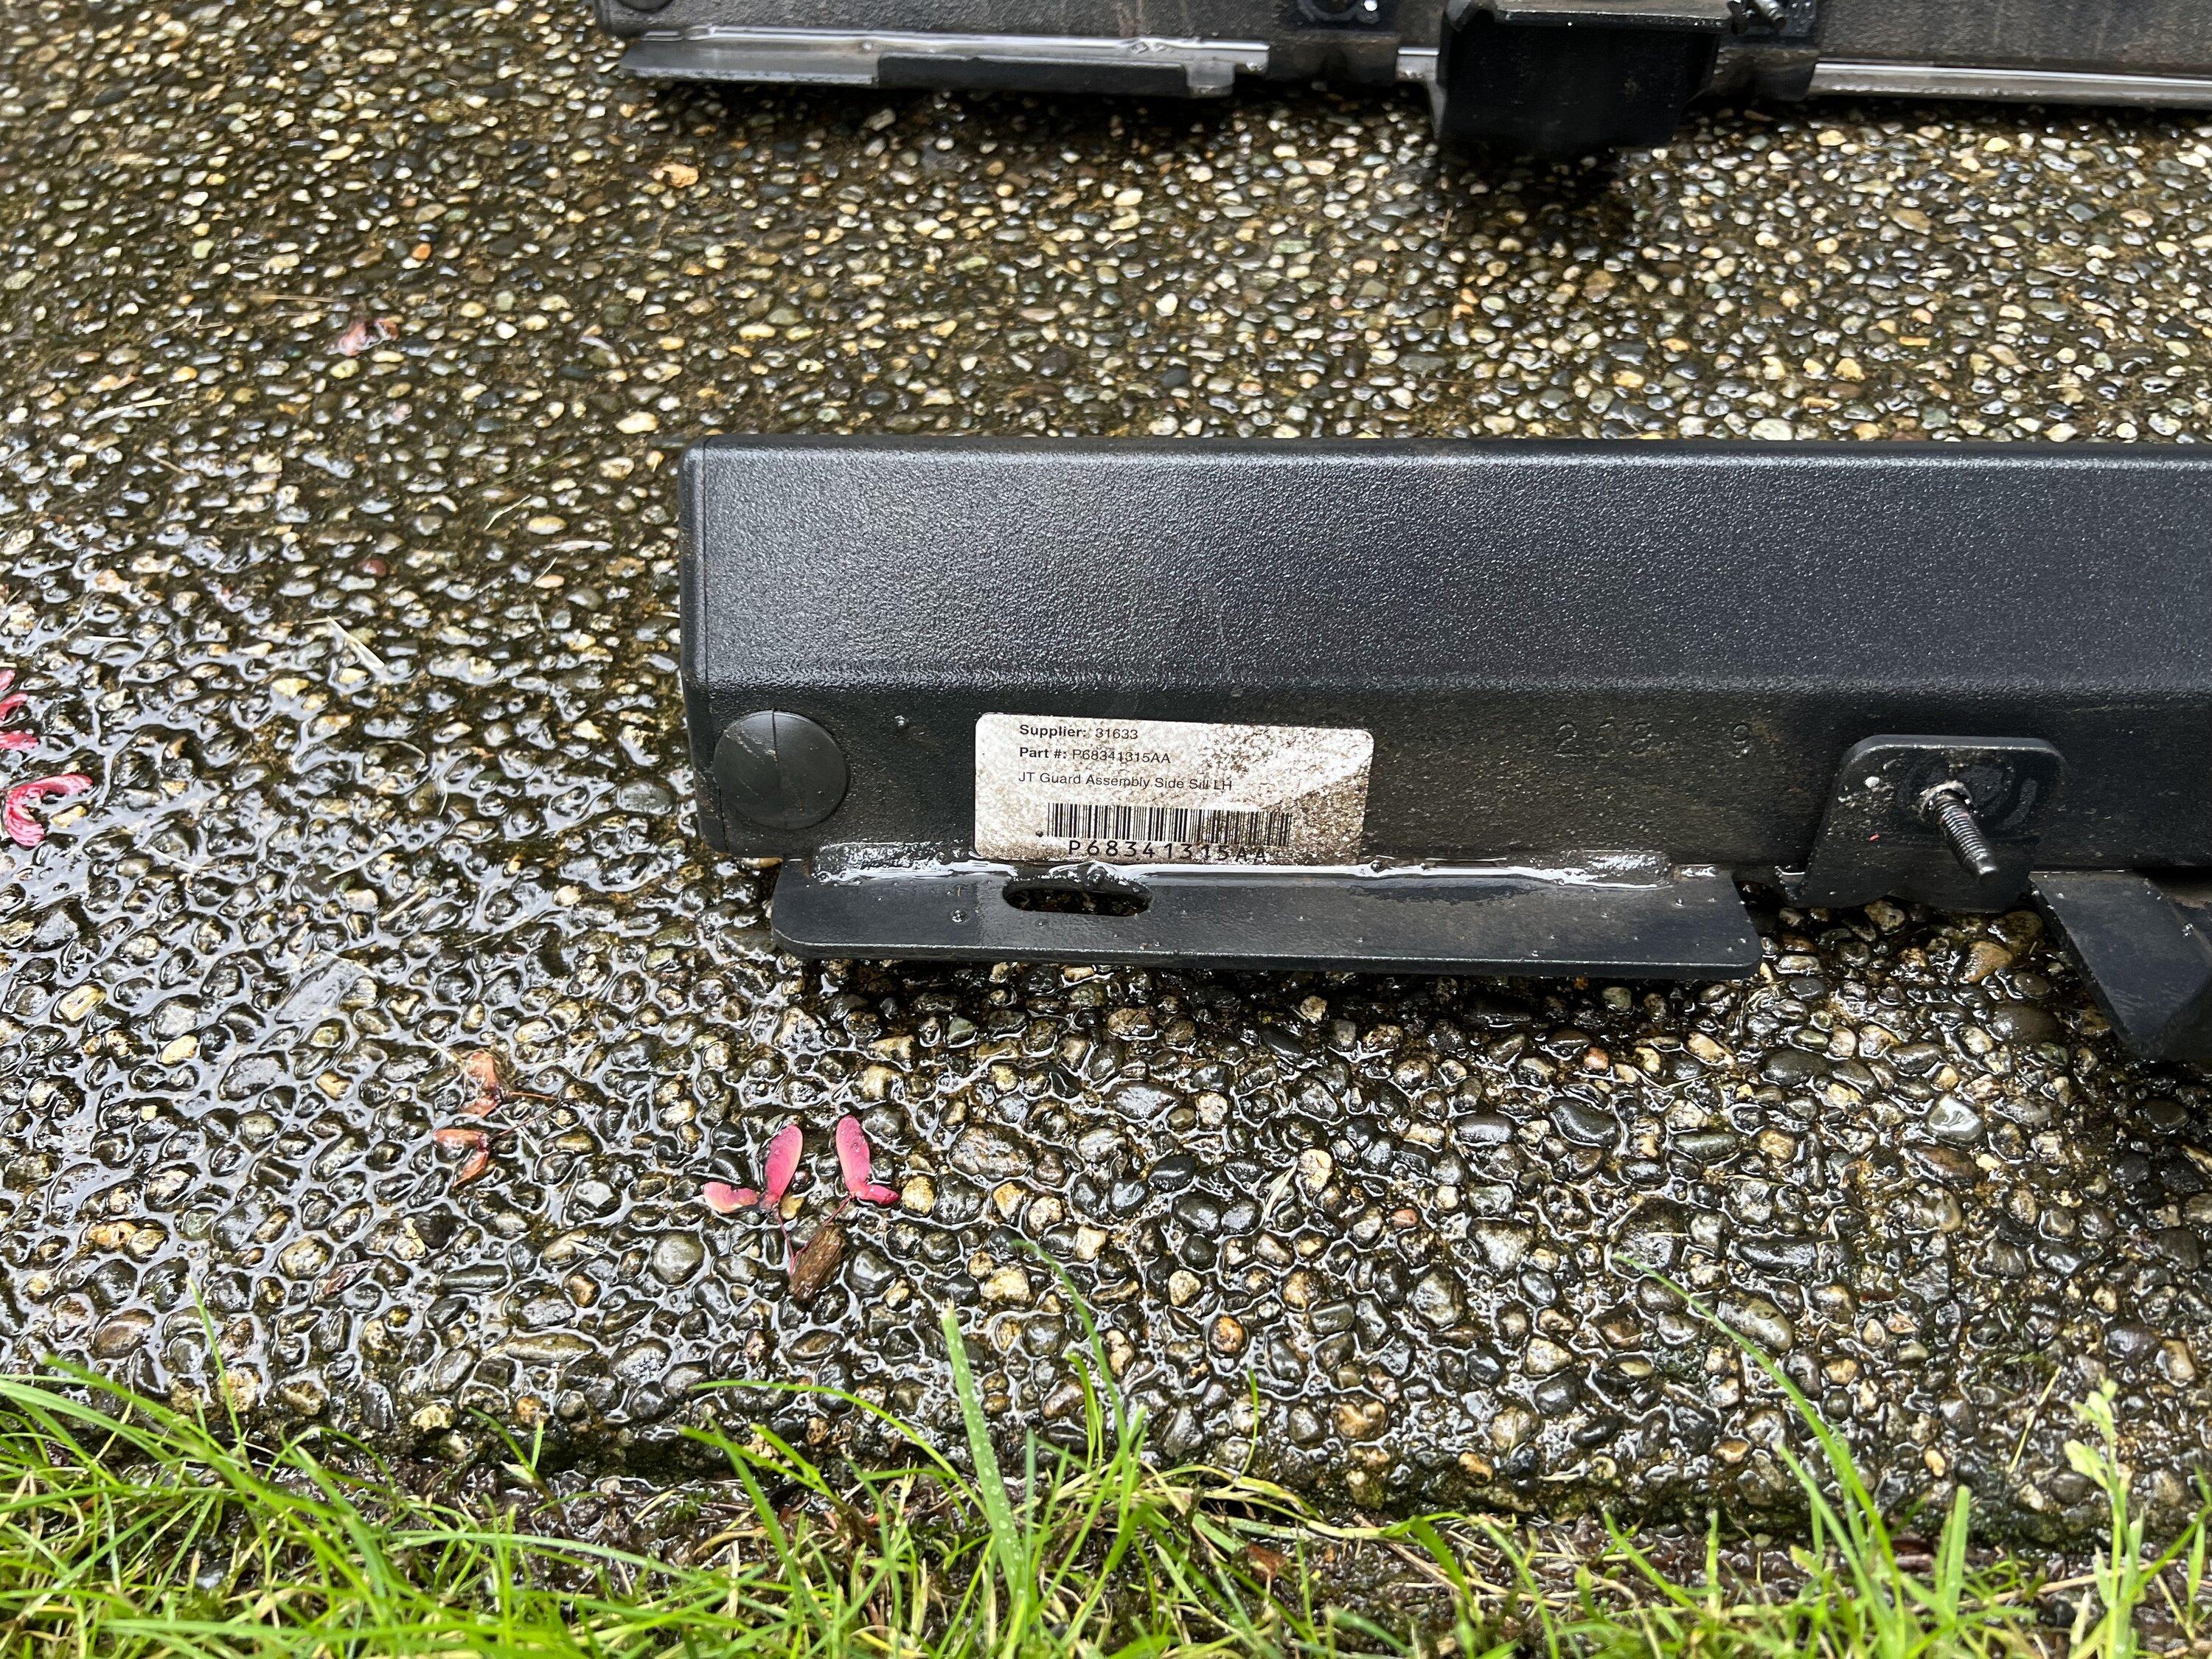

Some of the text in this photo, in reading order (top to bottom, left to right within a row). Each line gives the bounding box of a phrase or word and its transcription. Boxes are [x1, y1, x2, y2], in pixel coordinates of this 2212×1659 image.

[1019, 724, 1139, 740] Supplier: 31633
[1019, 747, 1172, 764] Part #: P68341315AA
[1018, 772, 1233, 791] JT Guard Assembly Side Sill LH
[1068, 839, 1268, 863] P68341315AA
